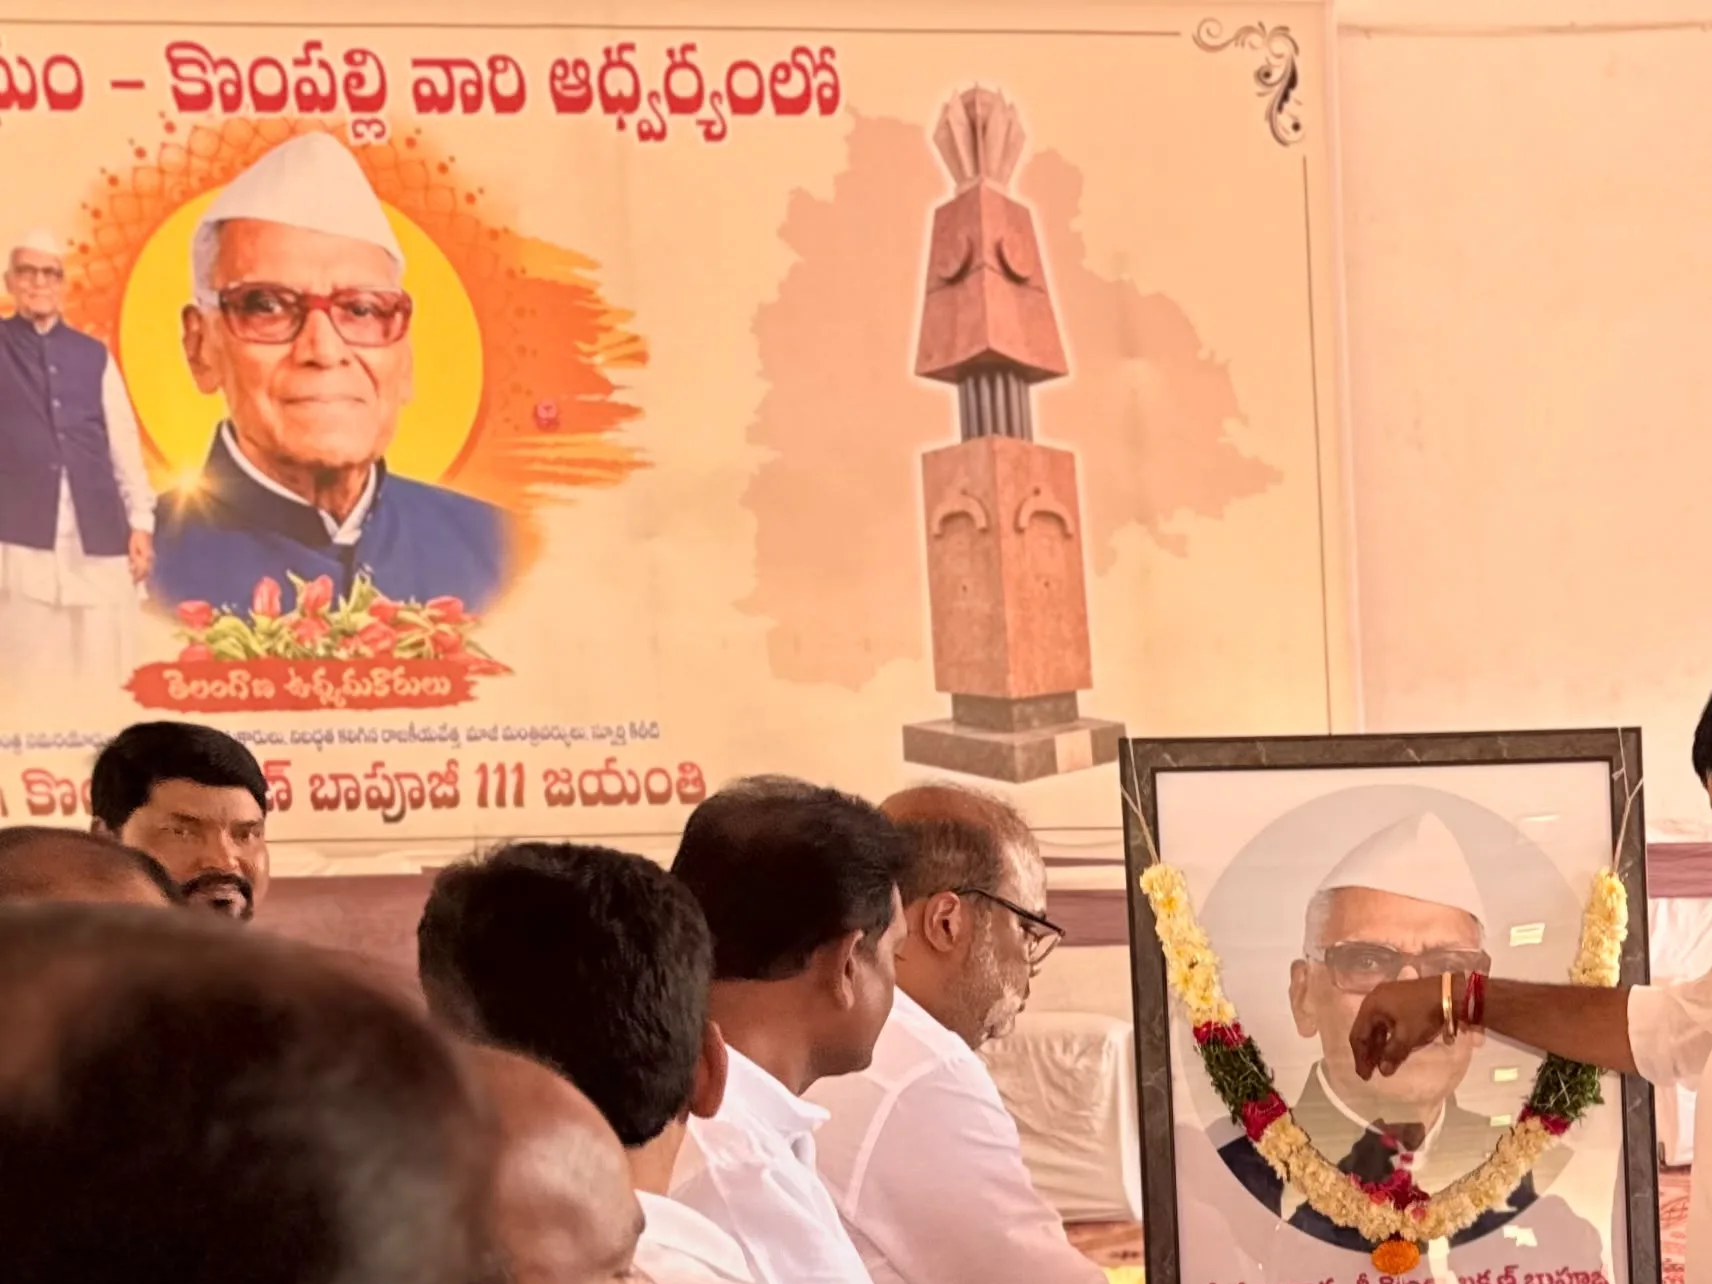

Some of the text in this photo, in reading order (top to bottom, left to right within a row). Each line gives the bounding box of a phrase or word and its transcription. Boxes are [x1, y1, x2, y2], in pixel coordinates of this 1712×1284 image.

[165, 41, 388, 146] కొంపల్లి
[411, 50, 527, 115] వారి
[549, 43, 841, 143] ఆధ్వర్యంలో
[309, 758, 460, 824] బాపూజీ
[475, 761, 526, 808] 111
[543, 756, 707, 807] జయంతి
